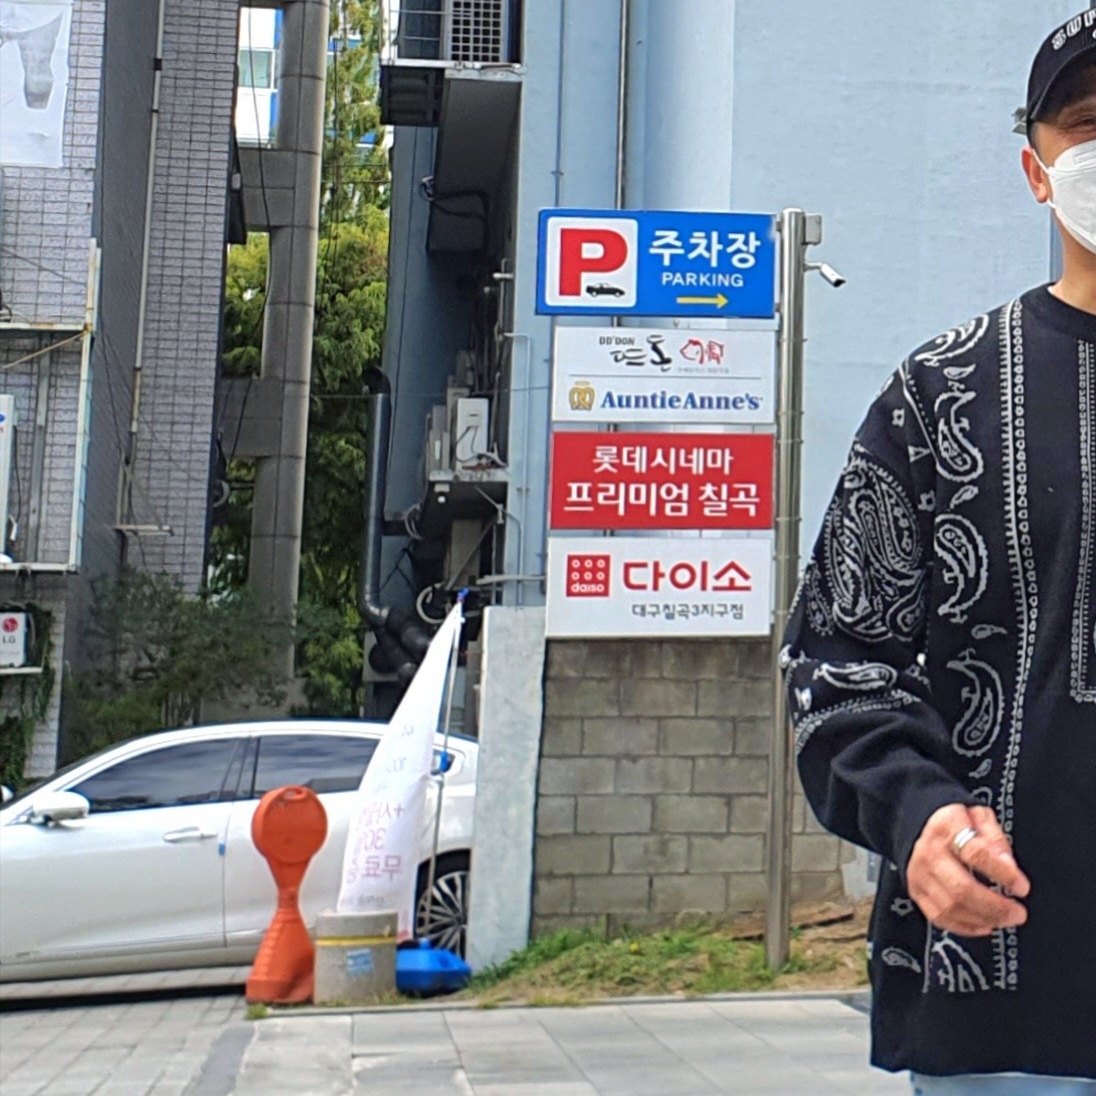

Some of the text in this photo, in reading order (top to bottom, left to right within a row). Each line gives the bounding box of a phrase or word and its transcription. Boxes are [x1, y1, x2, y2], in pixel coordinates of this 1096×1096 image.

[558, 227, 629, 297] P
[648, 229, 762, 269] 주차장
[661, 272, 745, 288] PARKING
[592, 445, 735, 475] 롯데시네마
[563, 481, 761, 517] 프리미엄 칠곡
[571, 581, 605, 593] daiso
[623, 560, 753, 593] 다이소
[631, 603, 745, 620] 대구칠곡3지구점
